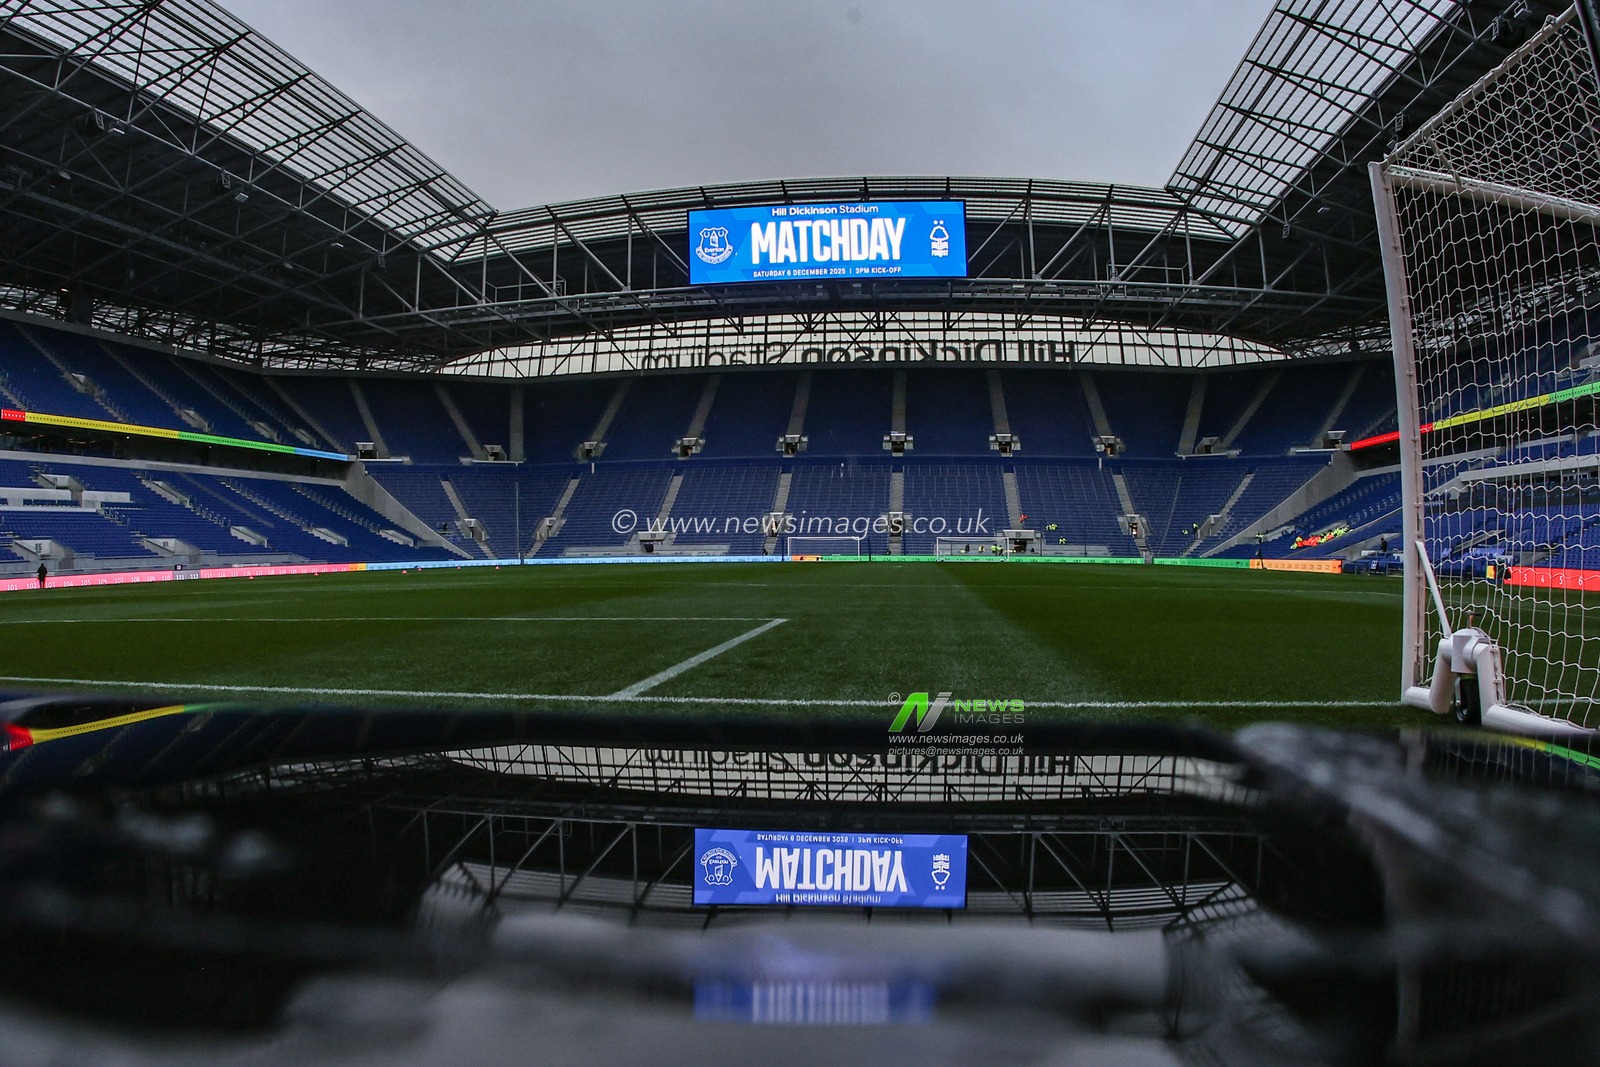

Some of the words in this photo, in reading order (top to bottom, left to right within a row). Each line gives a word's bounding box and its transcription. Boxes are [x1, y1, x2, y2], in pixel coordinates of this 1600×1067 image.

[772, 206, 787, 216] Hill
[789, 205, 838, 216] Dickinson
[839, 204, 879, 214] Stadium
[751, 217, 906, 265] MATCHDAY
[753, 270, 786, 278] SATURDAY
[792, 268, 828, 276] DECEMBER
[830, 268, 846, 276] 2025
[855, 267, 870, 275] 3PM
[871, 266, 902, 274] KICK-OFF
